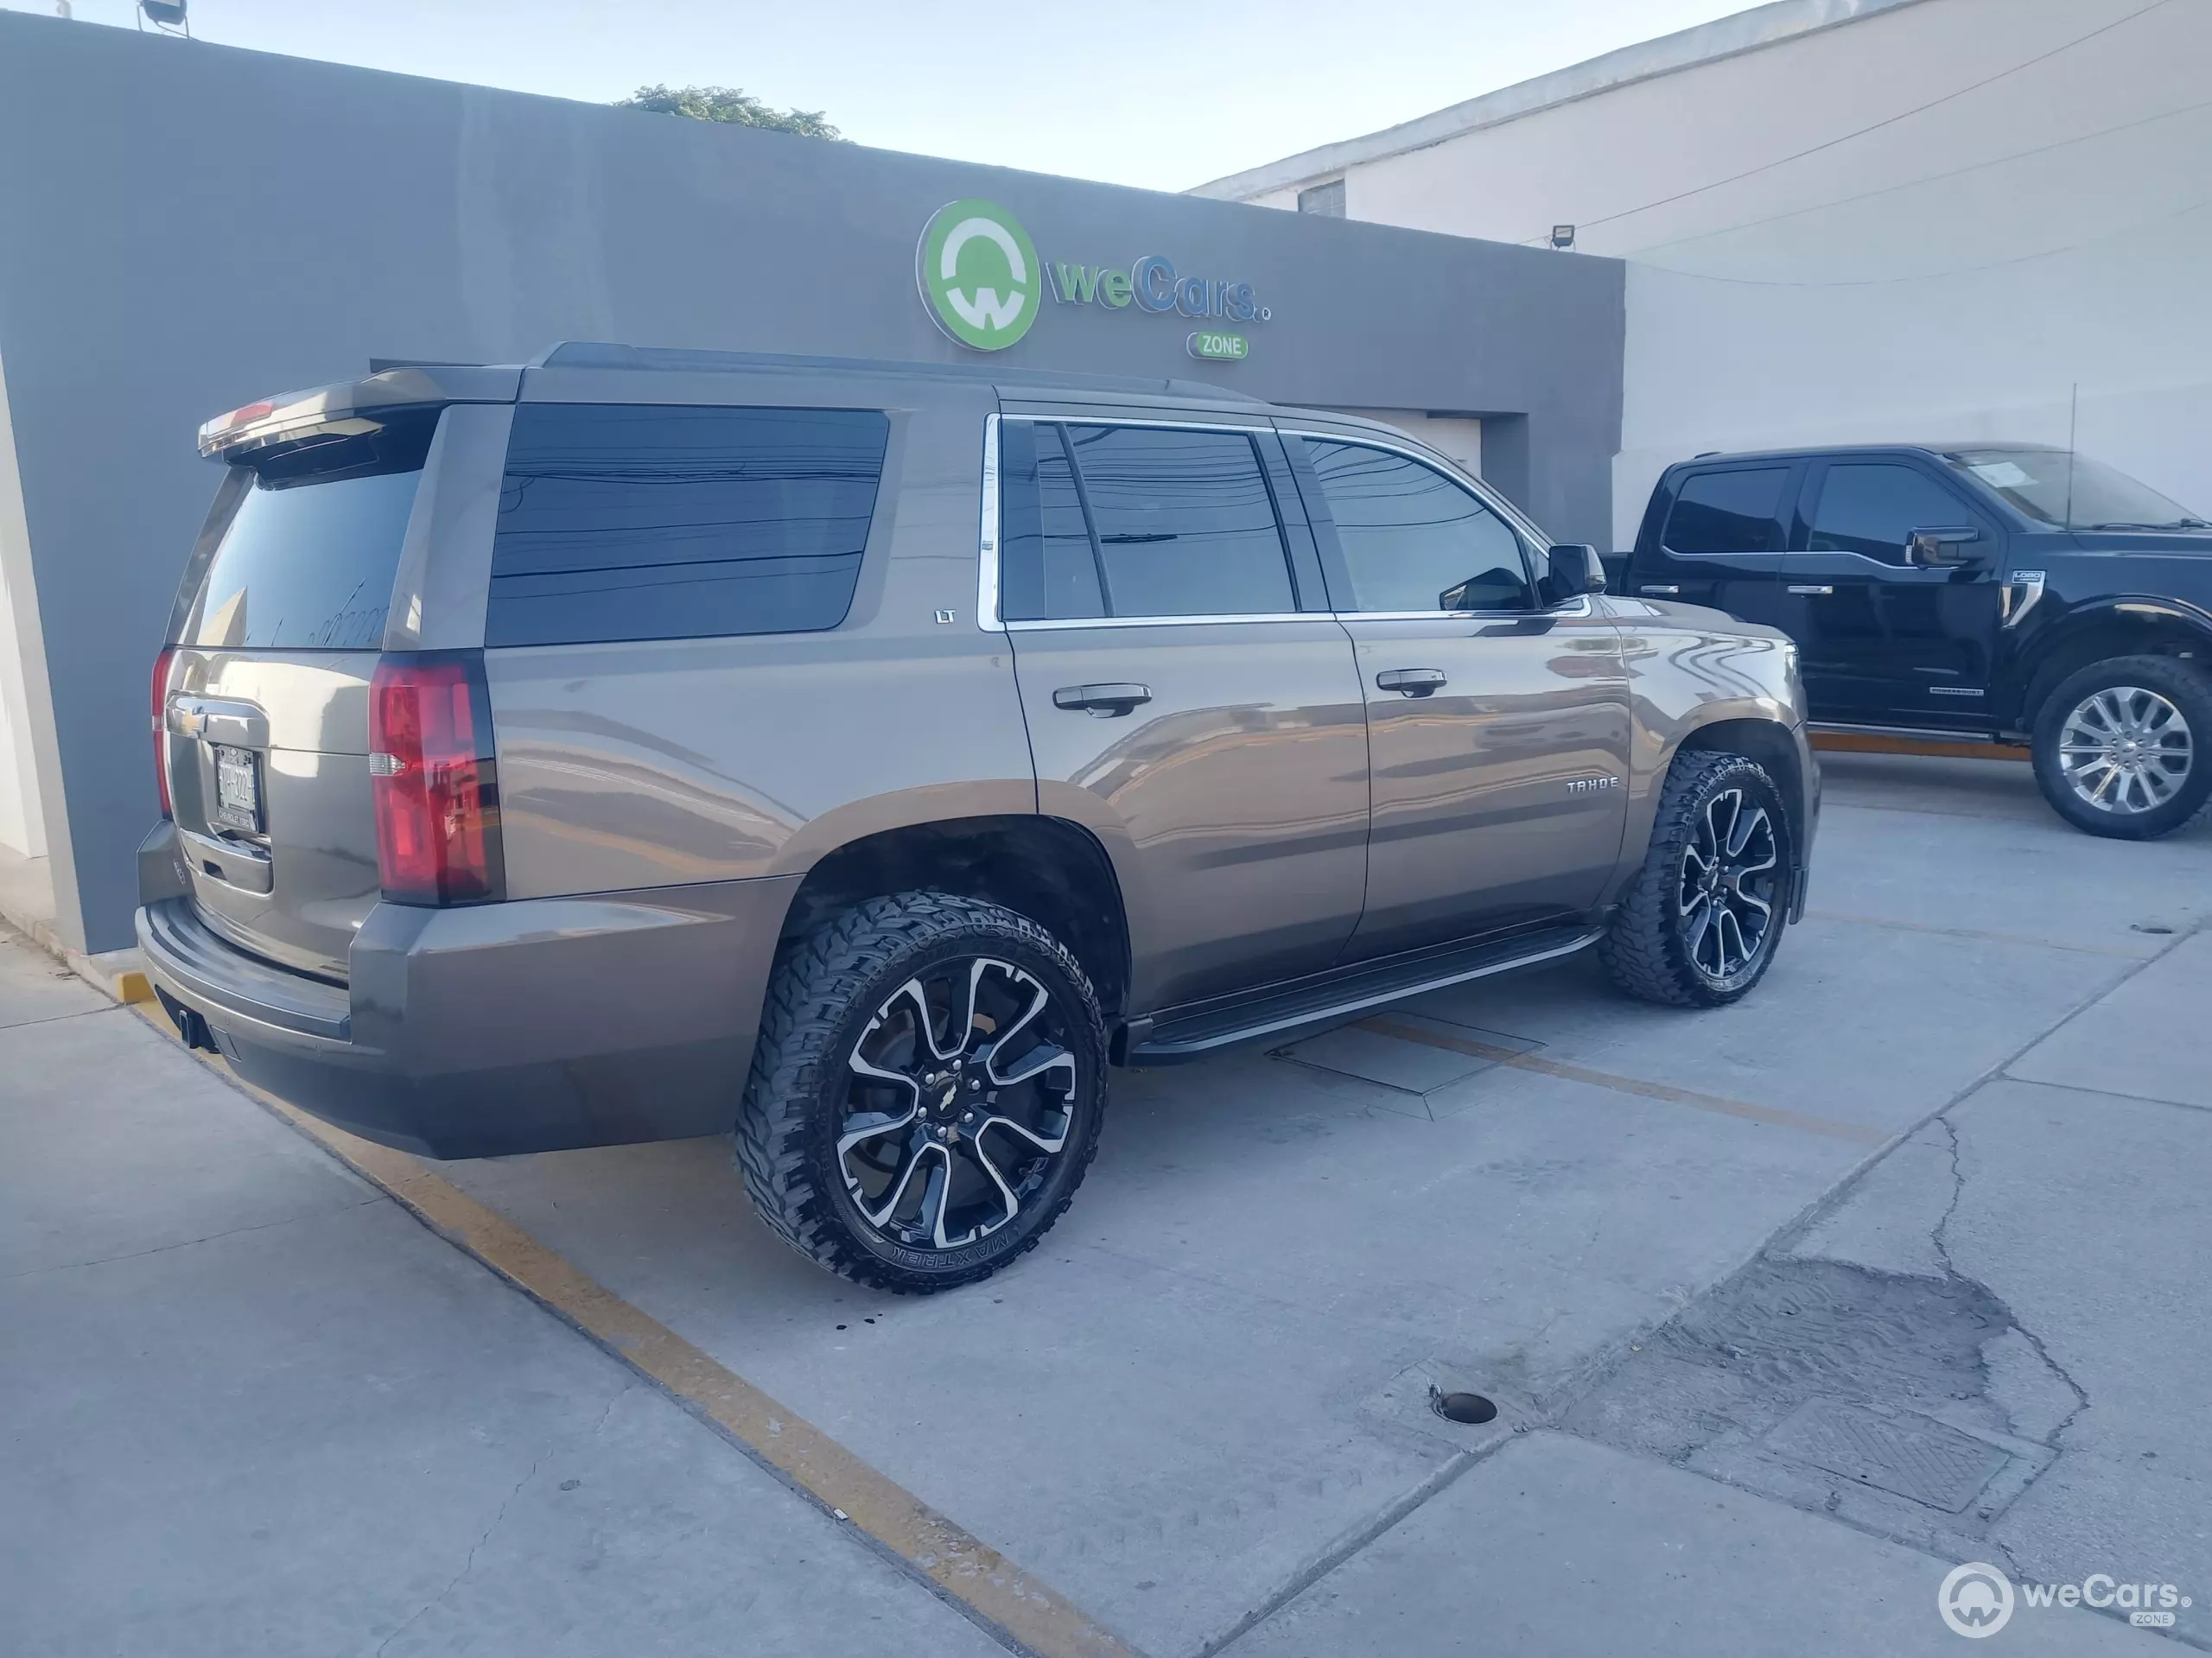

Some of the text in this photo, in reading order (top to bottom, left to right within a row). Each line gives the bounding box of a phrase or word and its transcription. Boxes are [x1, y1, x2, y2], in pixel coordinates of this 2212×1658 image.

[1202, 334, 1243, 355] ZONE
[935, 609, 956, 624] LT
[1567, 777, 1618, 794] TAHOE
